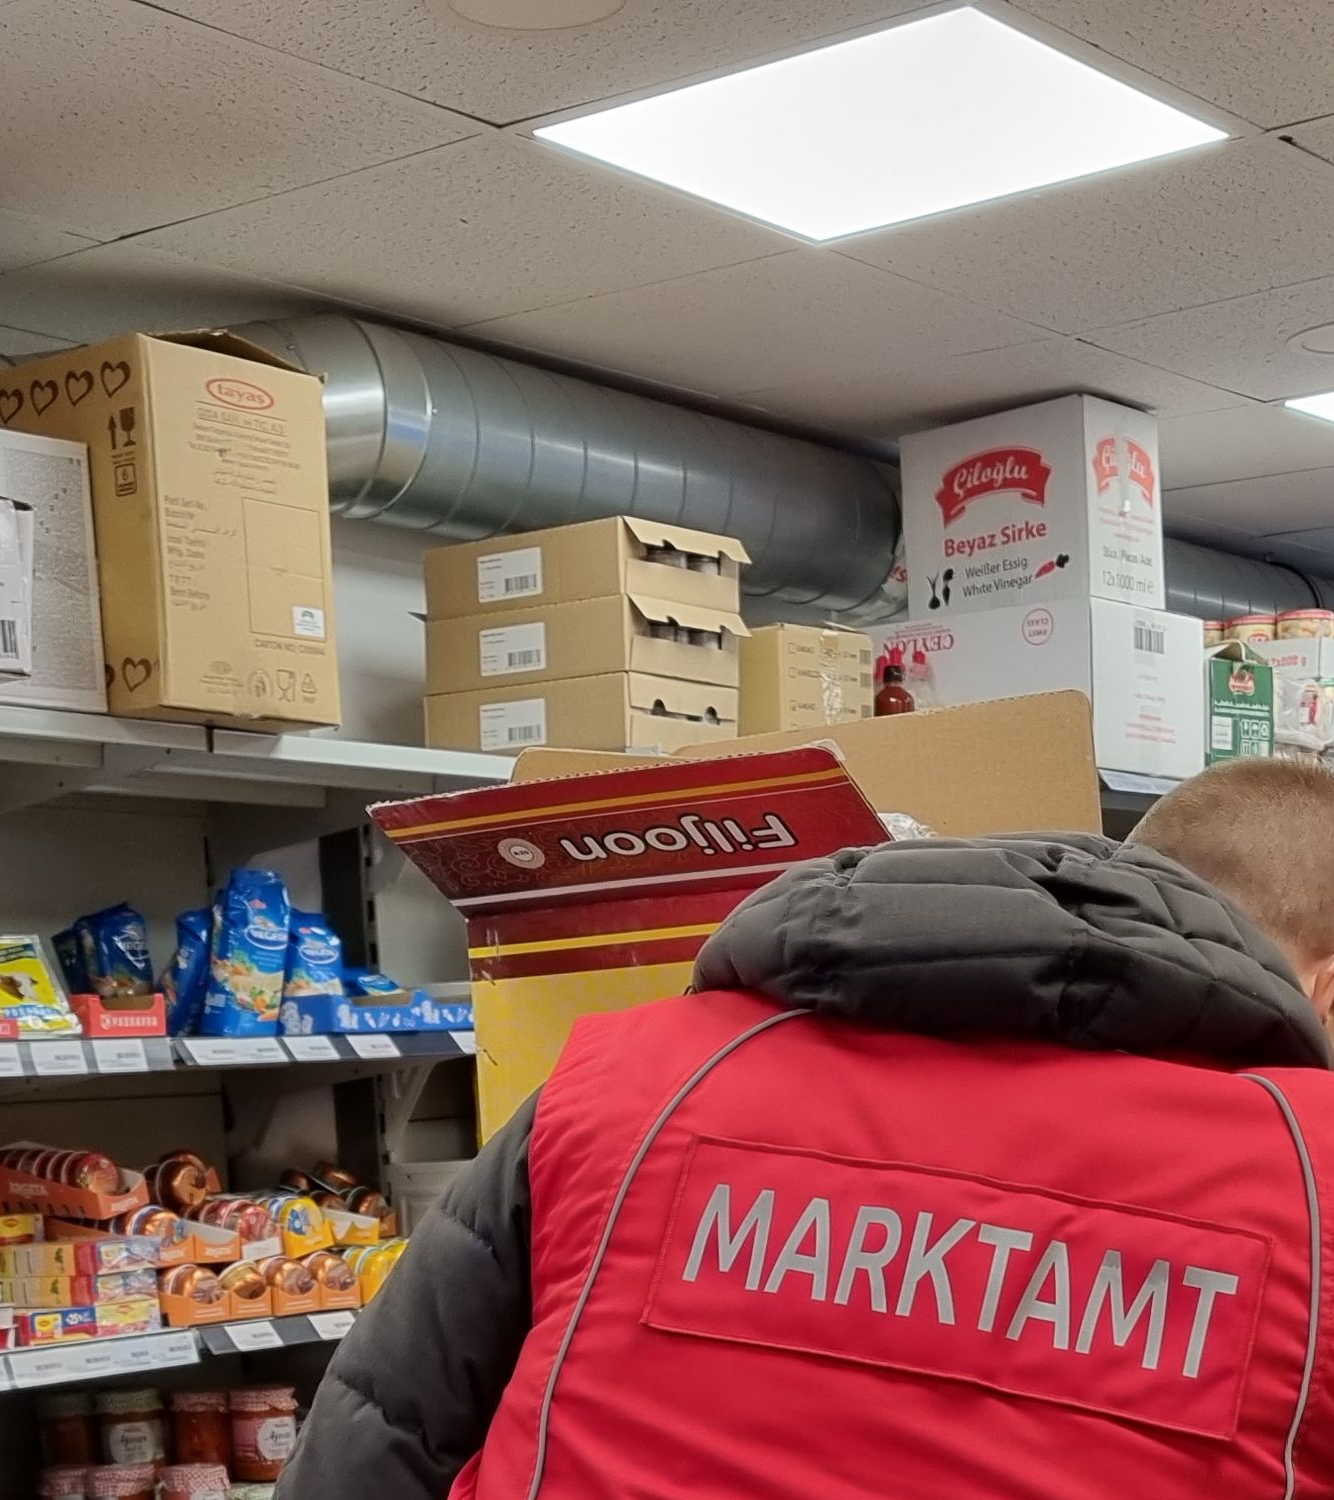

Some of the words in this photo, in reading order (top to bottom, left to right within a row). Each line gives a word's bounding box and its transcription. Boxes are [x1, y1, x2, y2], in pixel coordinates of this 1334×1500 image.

[217, 383, 265, 405] tayas
[953, 457, 1029, 496] Çiloğlu
[944, 534, 996, 558] Beyaz
[1001, 521, 1047, 546] Sirke
[962, 581, 992, 599] White
[993, 573, 1033, 596] Vinegar
[965, 561, 1001, 580] Weißer
[1002, 556, 1028, 575] Essig
[559, 813, 799, 861] Filjoon
[681, 1184, 1240, 1379] MARKTAMT
